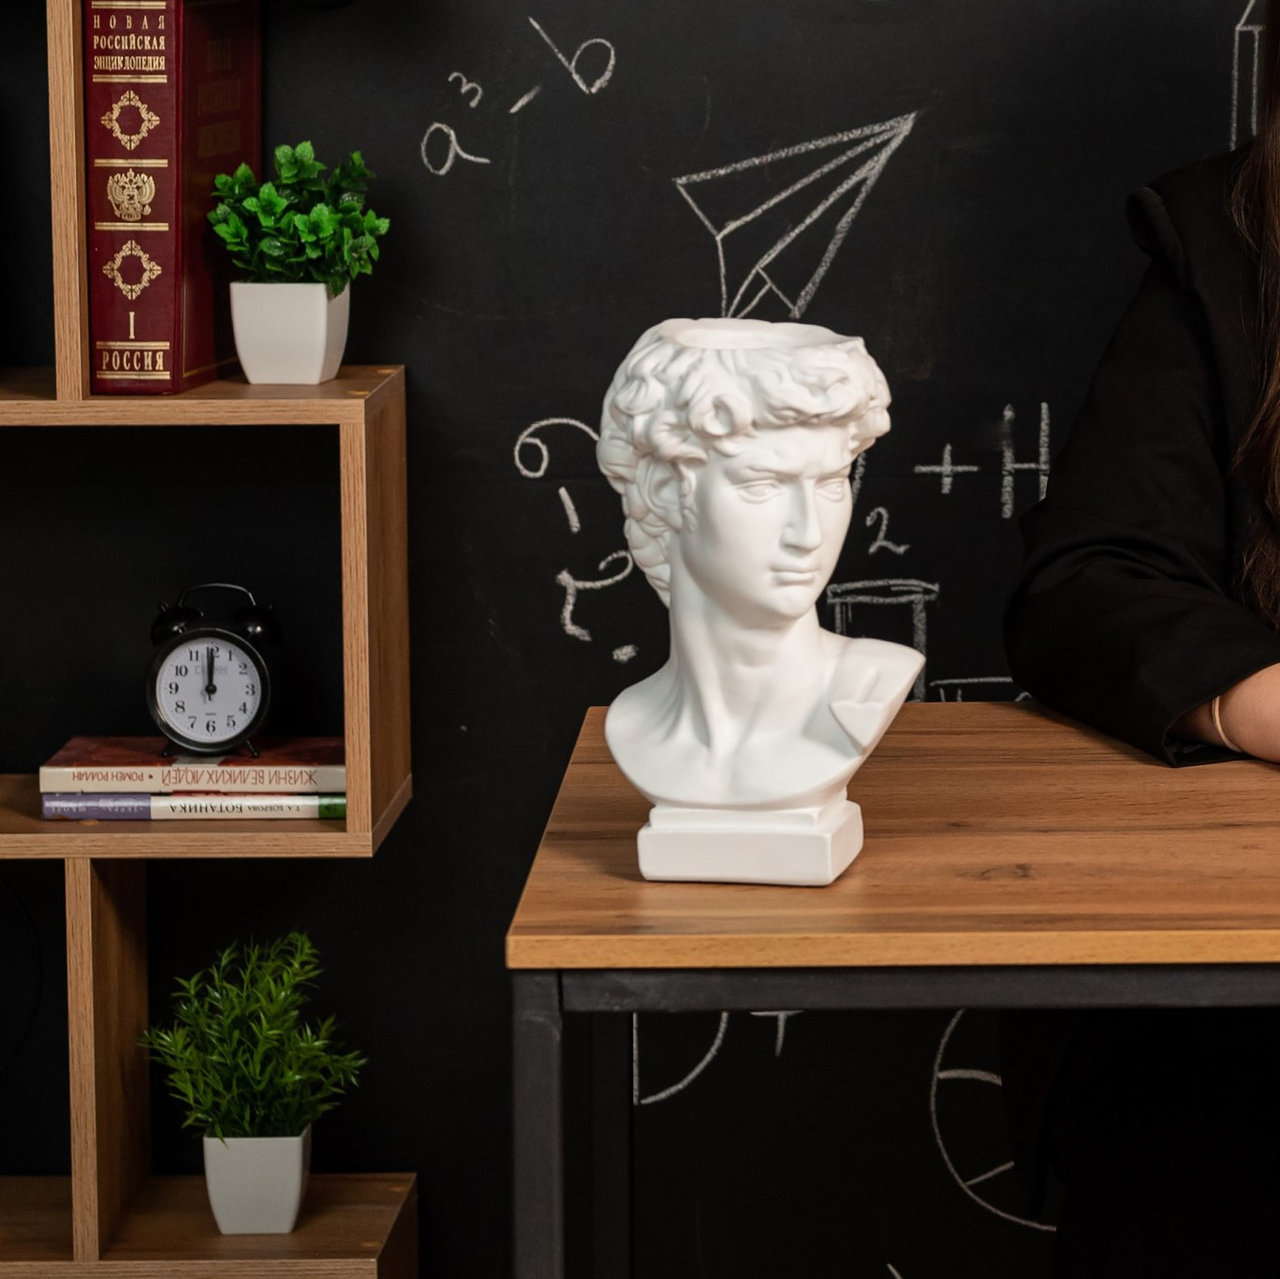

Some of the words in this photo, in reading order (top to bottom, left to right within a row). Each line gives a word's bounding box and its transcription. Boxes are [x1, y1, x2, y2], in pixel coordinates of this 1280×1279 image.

[93, 15, 166, 30] НОВАЯ
[93, 34, 166, 51] РОССИЙСКАЯ
[93, 55, 166, 71] ЭНЦИКЛОПЕДИЯ
[102, 351, 165, 371] РОССИЯ
[174, 665, 188, 677] 10
[238, 663, 248, 676] 2
[169, 682, 179, 695] 9
[245, 684, 256, 696] 3
[174, 700, 185, 713] 8
[239, 702, 248, 714] 4
[188, 716, 197, 729] 7
[206, 720, 216, 733] 6
[226, 715, 236, 728] 5
[72, 770, 109, 782] РОЛЛАН
[111, 770, 144, 782] РОМЕН
[161, 767, 207, 787] ЛЮДЕЙ
[207, 769, 264, 786] ВЕЛИКИХ
[268, 769, 318, 785] ЖИЗНИ
[169, 802, 243, 814] БОТАНИКА
[247, 804, 284, 812] БОБРОВА
